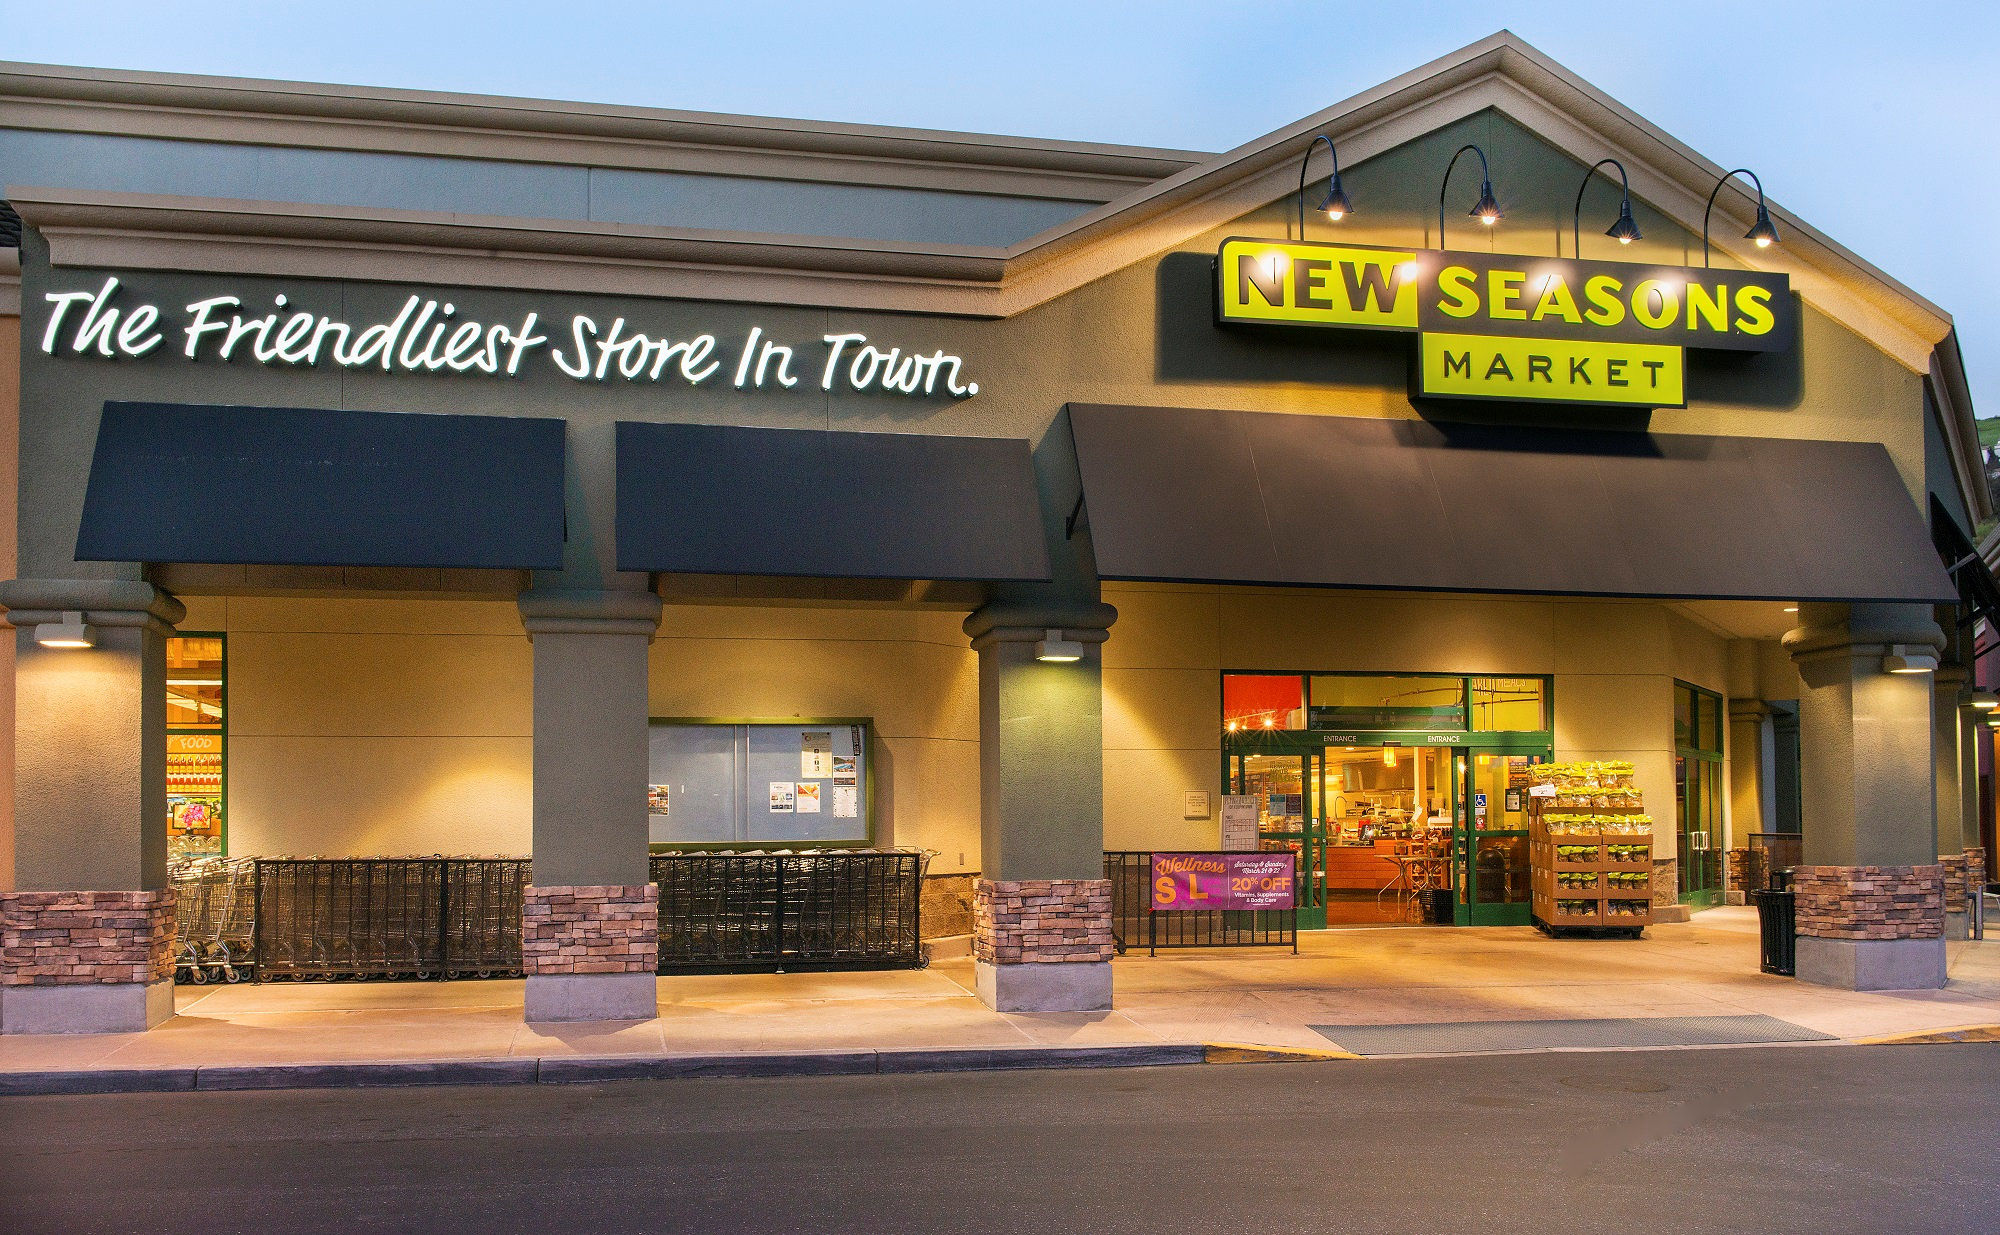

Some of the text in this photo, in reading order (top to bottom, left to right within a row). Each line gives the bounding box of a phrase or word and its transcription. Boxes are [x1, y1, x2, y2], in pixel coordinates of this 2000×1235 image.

[1238, 254, 1776, 336] NEW SEASONS
[41, 276, 979, 396] The Friendliest Store In Town.
[1442, 350, 1665, 389] MARKET
[180, 736, 213, 750] FOOD
[1323, 735, 1357, 743] ENTRANCE
[1427, 735, 1461, 743] ENTRANCE
[1155, 857, 1227, 876] Wellness
[1231, 876, 1292, 891] 20% OFF
